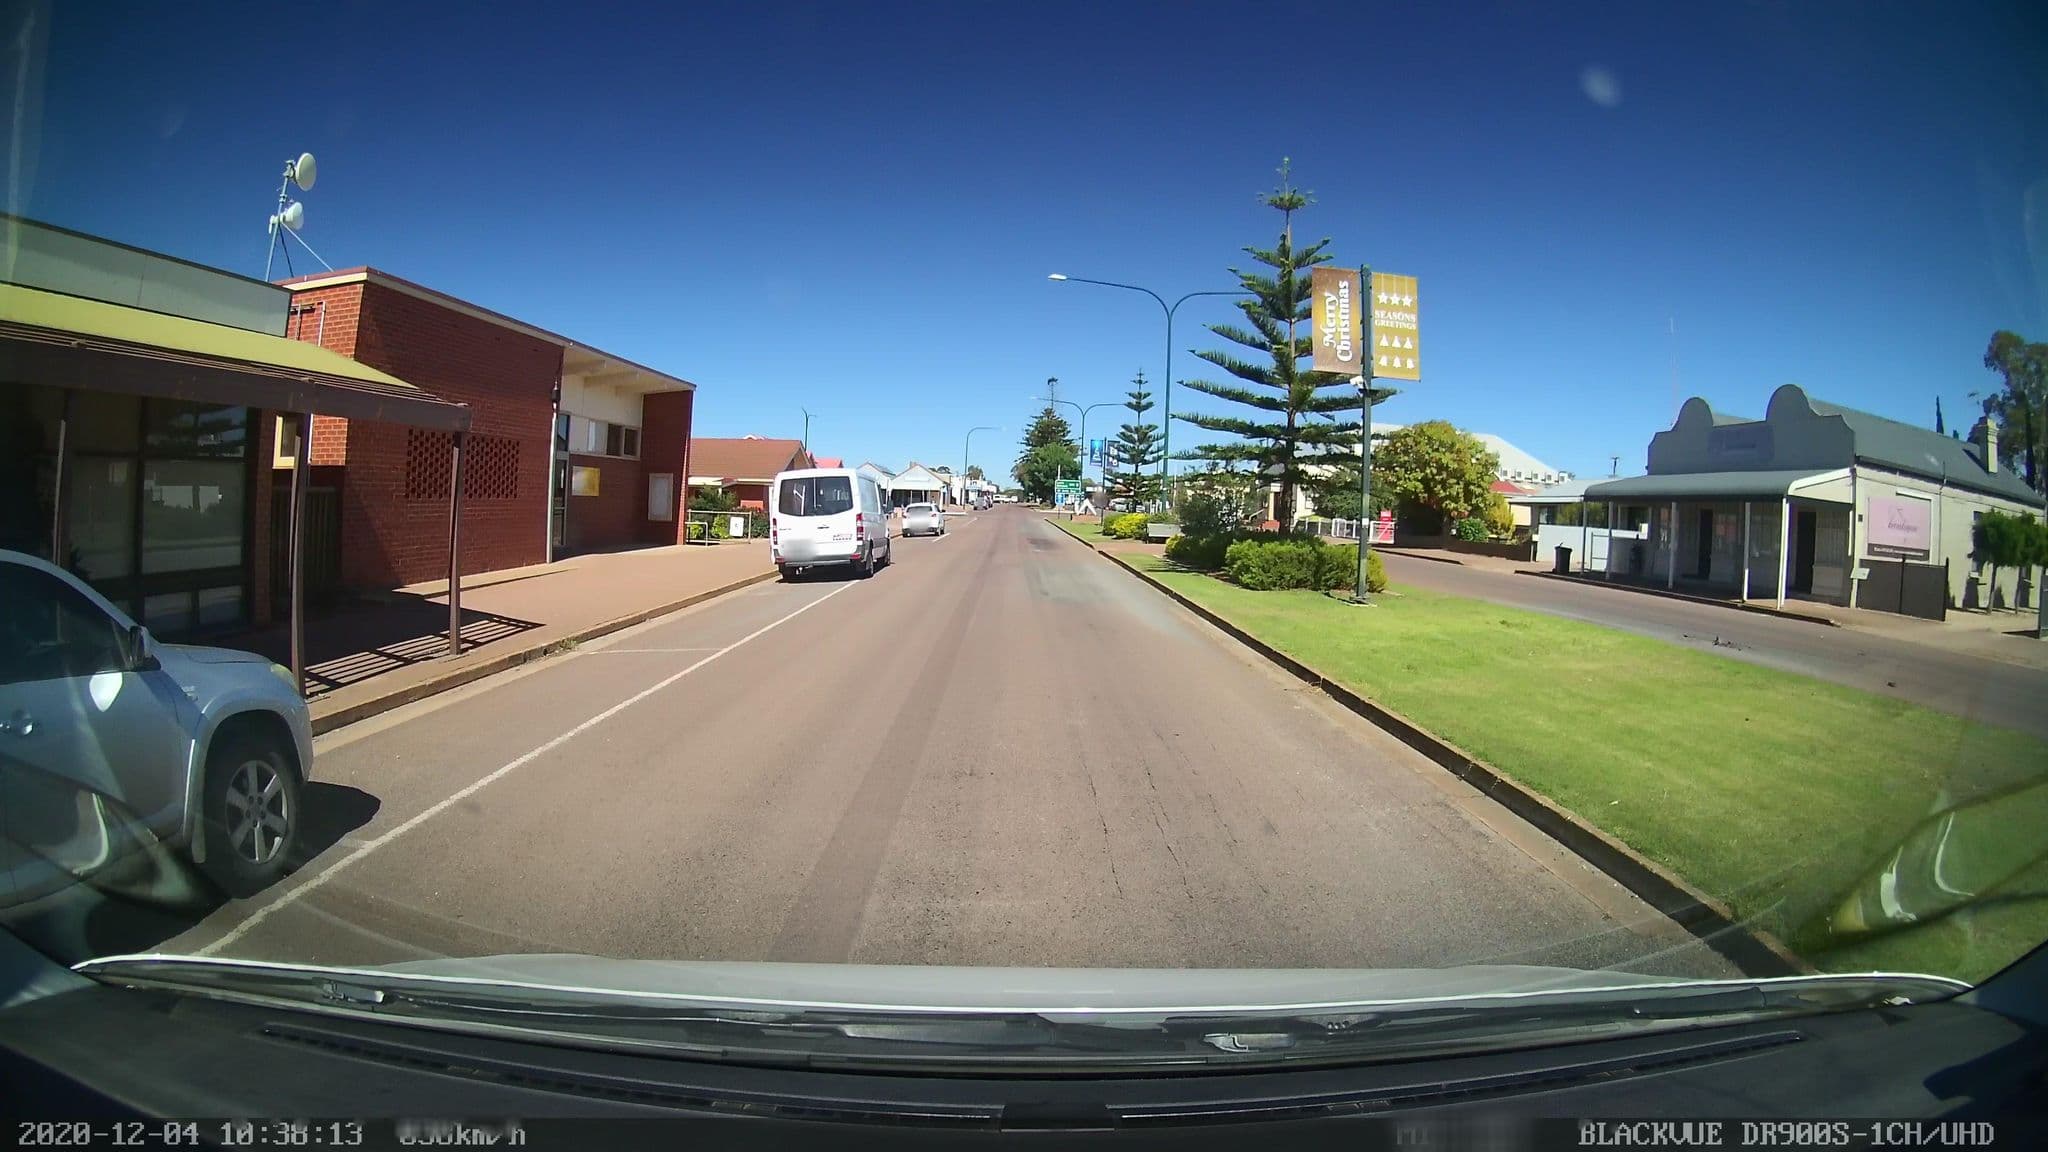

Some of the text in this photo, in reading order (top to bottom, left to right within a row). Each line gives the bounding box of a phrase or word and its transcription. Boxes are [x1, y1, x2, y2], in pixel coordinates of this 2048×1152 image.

[1320, 291, 1339, 348] Merry
[1336, 280, 1353, 362] Christmas
[1375, 310, 1416, 323] SEASONS
[1375, 319, 1417, 330] GREETINGS
